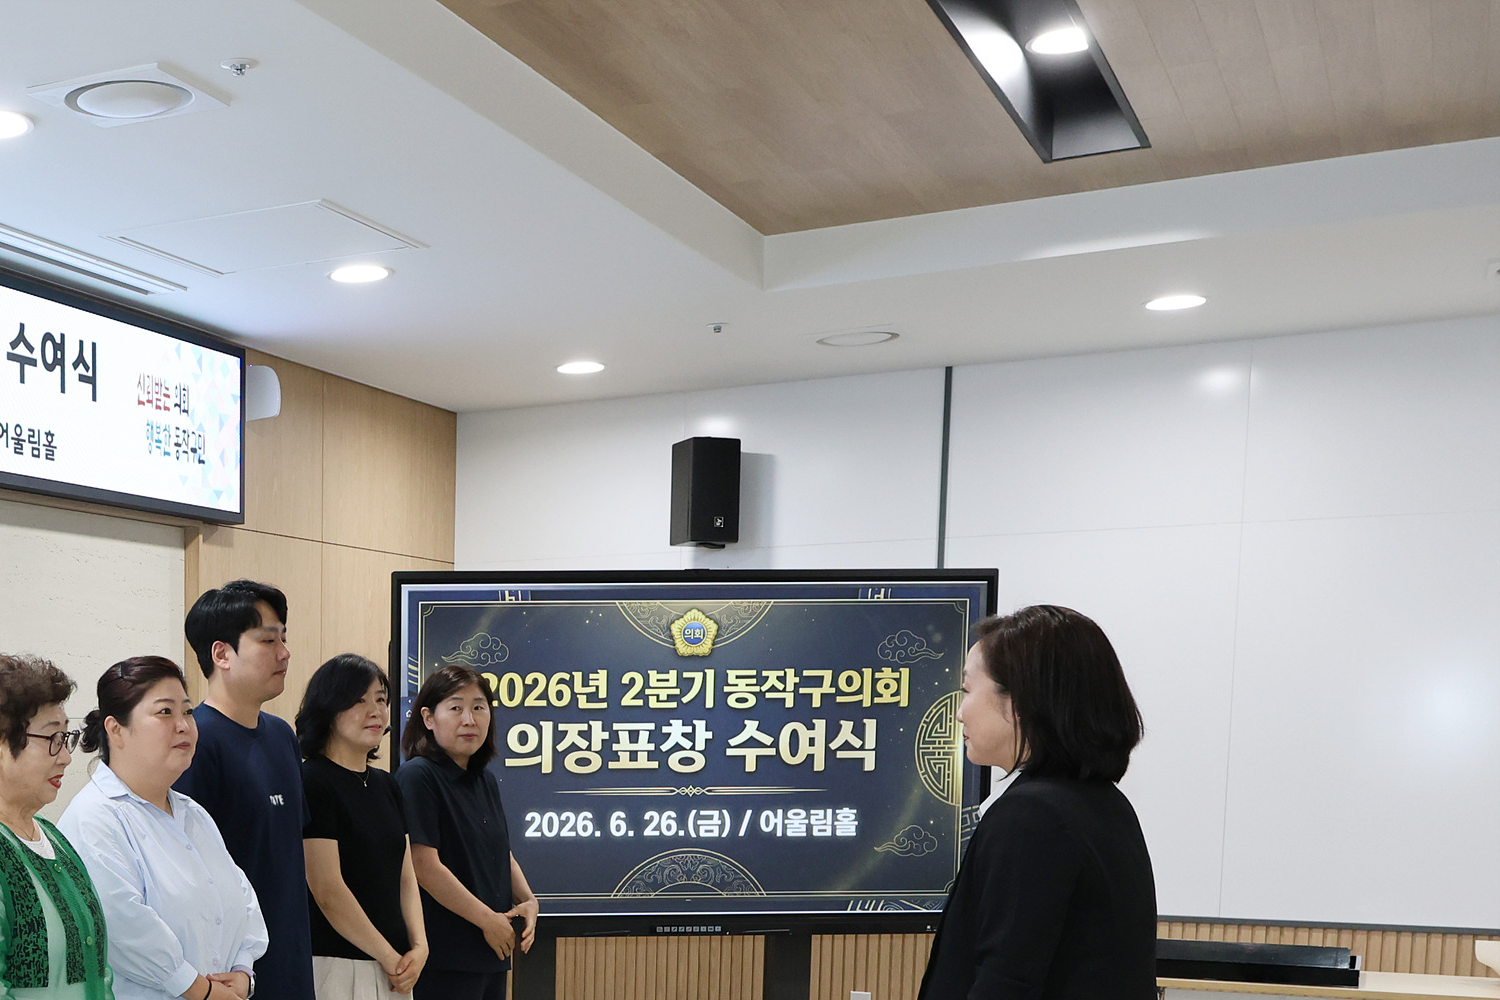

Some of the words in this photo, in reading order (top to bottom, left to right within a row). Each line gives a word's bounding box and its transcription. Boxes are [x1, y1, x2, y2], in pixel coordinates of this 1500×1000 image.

[6, 322, 97, 403] 수여식
[137, 372, 171, 412] 신뢰받는
[174, 382, 190, 417] 의회
[146, 419, 171, 457] 행복한
[173, 426, 206, 465] 동작구민
[684, 628, 704, 640] 의회
[480, 668, 609, 710] 2026년
[620, 668, 715, 709] 2분기
[723, 667, 910, 709] 동작구의회
[504, 719, 713, 774] 의장표창
[725, 718, 878, 772] 수여식
[524, 811, 601, 838] 2026.
[609, 810, 635, 838] 6.
[643, 809, 731, 838] 26.(금)
[759, 807, 859, 838] 어울림홀
